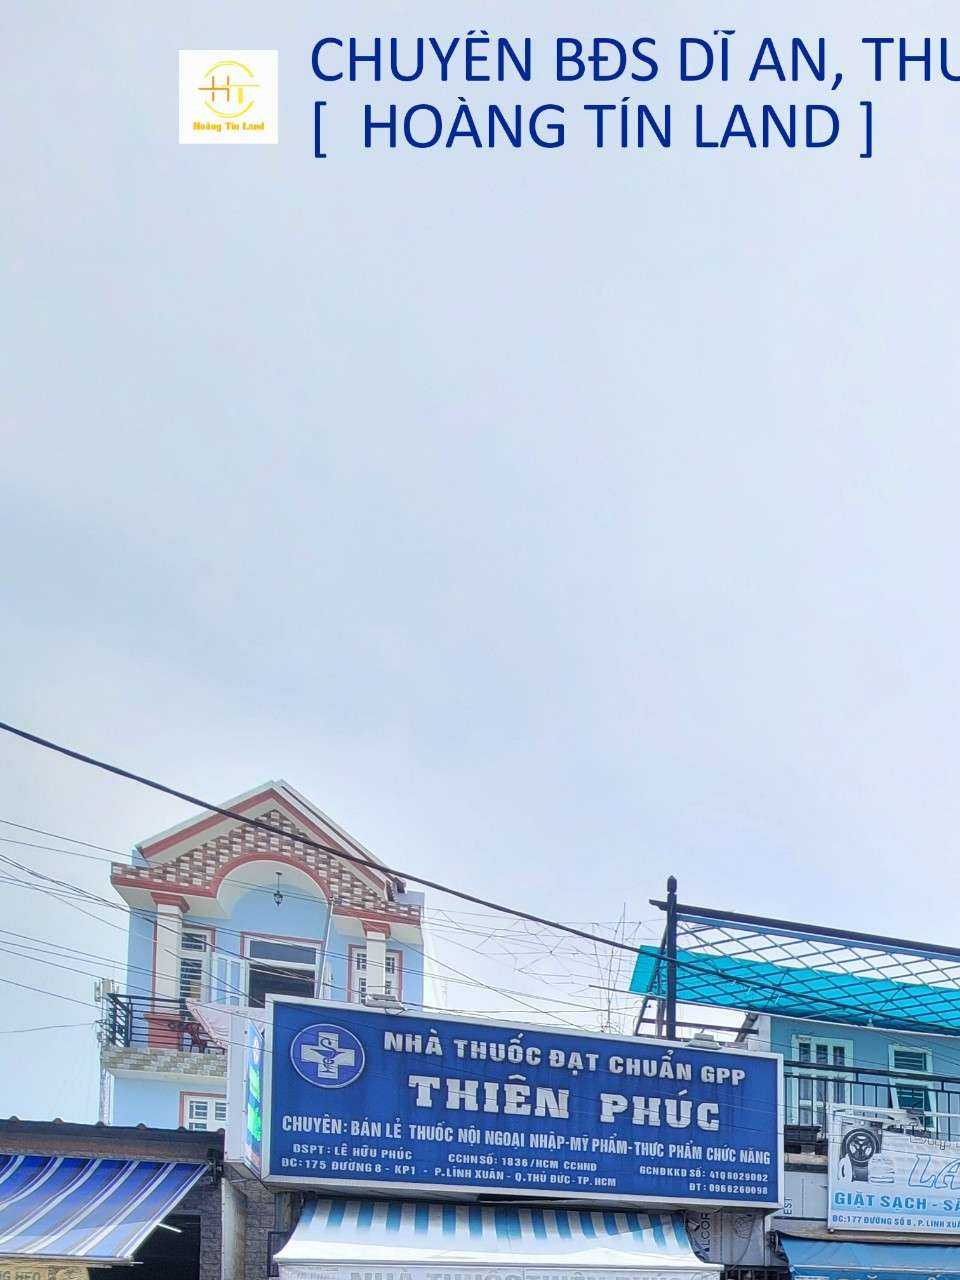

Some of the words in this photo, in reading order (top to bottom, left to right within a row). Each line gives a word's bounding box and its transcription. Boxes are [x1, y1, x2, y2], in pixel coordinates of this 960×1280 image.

[384, 1029, 443, 1057] NHÀ
[454, 1032, 541, 1065] THUỐC
[549, 1050, 599, 1077] ĐẠT
[608, 1050, 692, 1081] CHUẨN
[700, 1066, 746, 1086] GPP
[409, 1074, 569, 1119] THIÊN
[600, 1089, 720, 1131] PHÚC
[283, 1114, 347, 1136] CHUYÊN:
[350, 1117, 380, 1139] BÁN
[385, 1118, 403, 1140] LẺ
[409, 1120, 453, 1142] THUỐC
[458, 1126, 481, 1145] NỘI
[485, 1130, 525, 1149] NGOẠI
[635, 1141, 665, 1160] THỰC
[668, 1139, 703, 1160] PHẨM
[706, 1145, 737, 1163] CHỨC
[739, 1148, 771, 1165] NĂNG
[334, 1143, 349, 1157] LÊ
[352, 1144, 378, 1158] HỮU
[382, 1146, 412, 1160] PHÚC
[331, 1158, 372, 1172] ĐƯỜNG
[394, 1164, 416, 1175] KP1
[475, 1168, 505, 1181] XUÂN
[834, 1191, 875, 1209] GIẶT
[880, 1195, 928, 1211] SẠCH
[864, 1215, 892, 1226] ĐƯỜNG
[894, 1216, 905, 1226] SỐ
[926, 1219, 944, 1228] LINH
